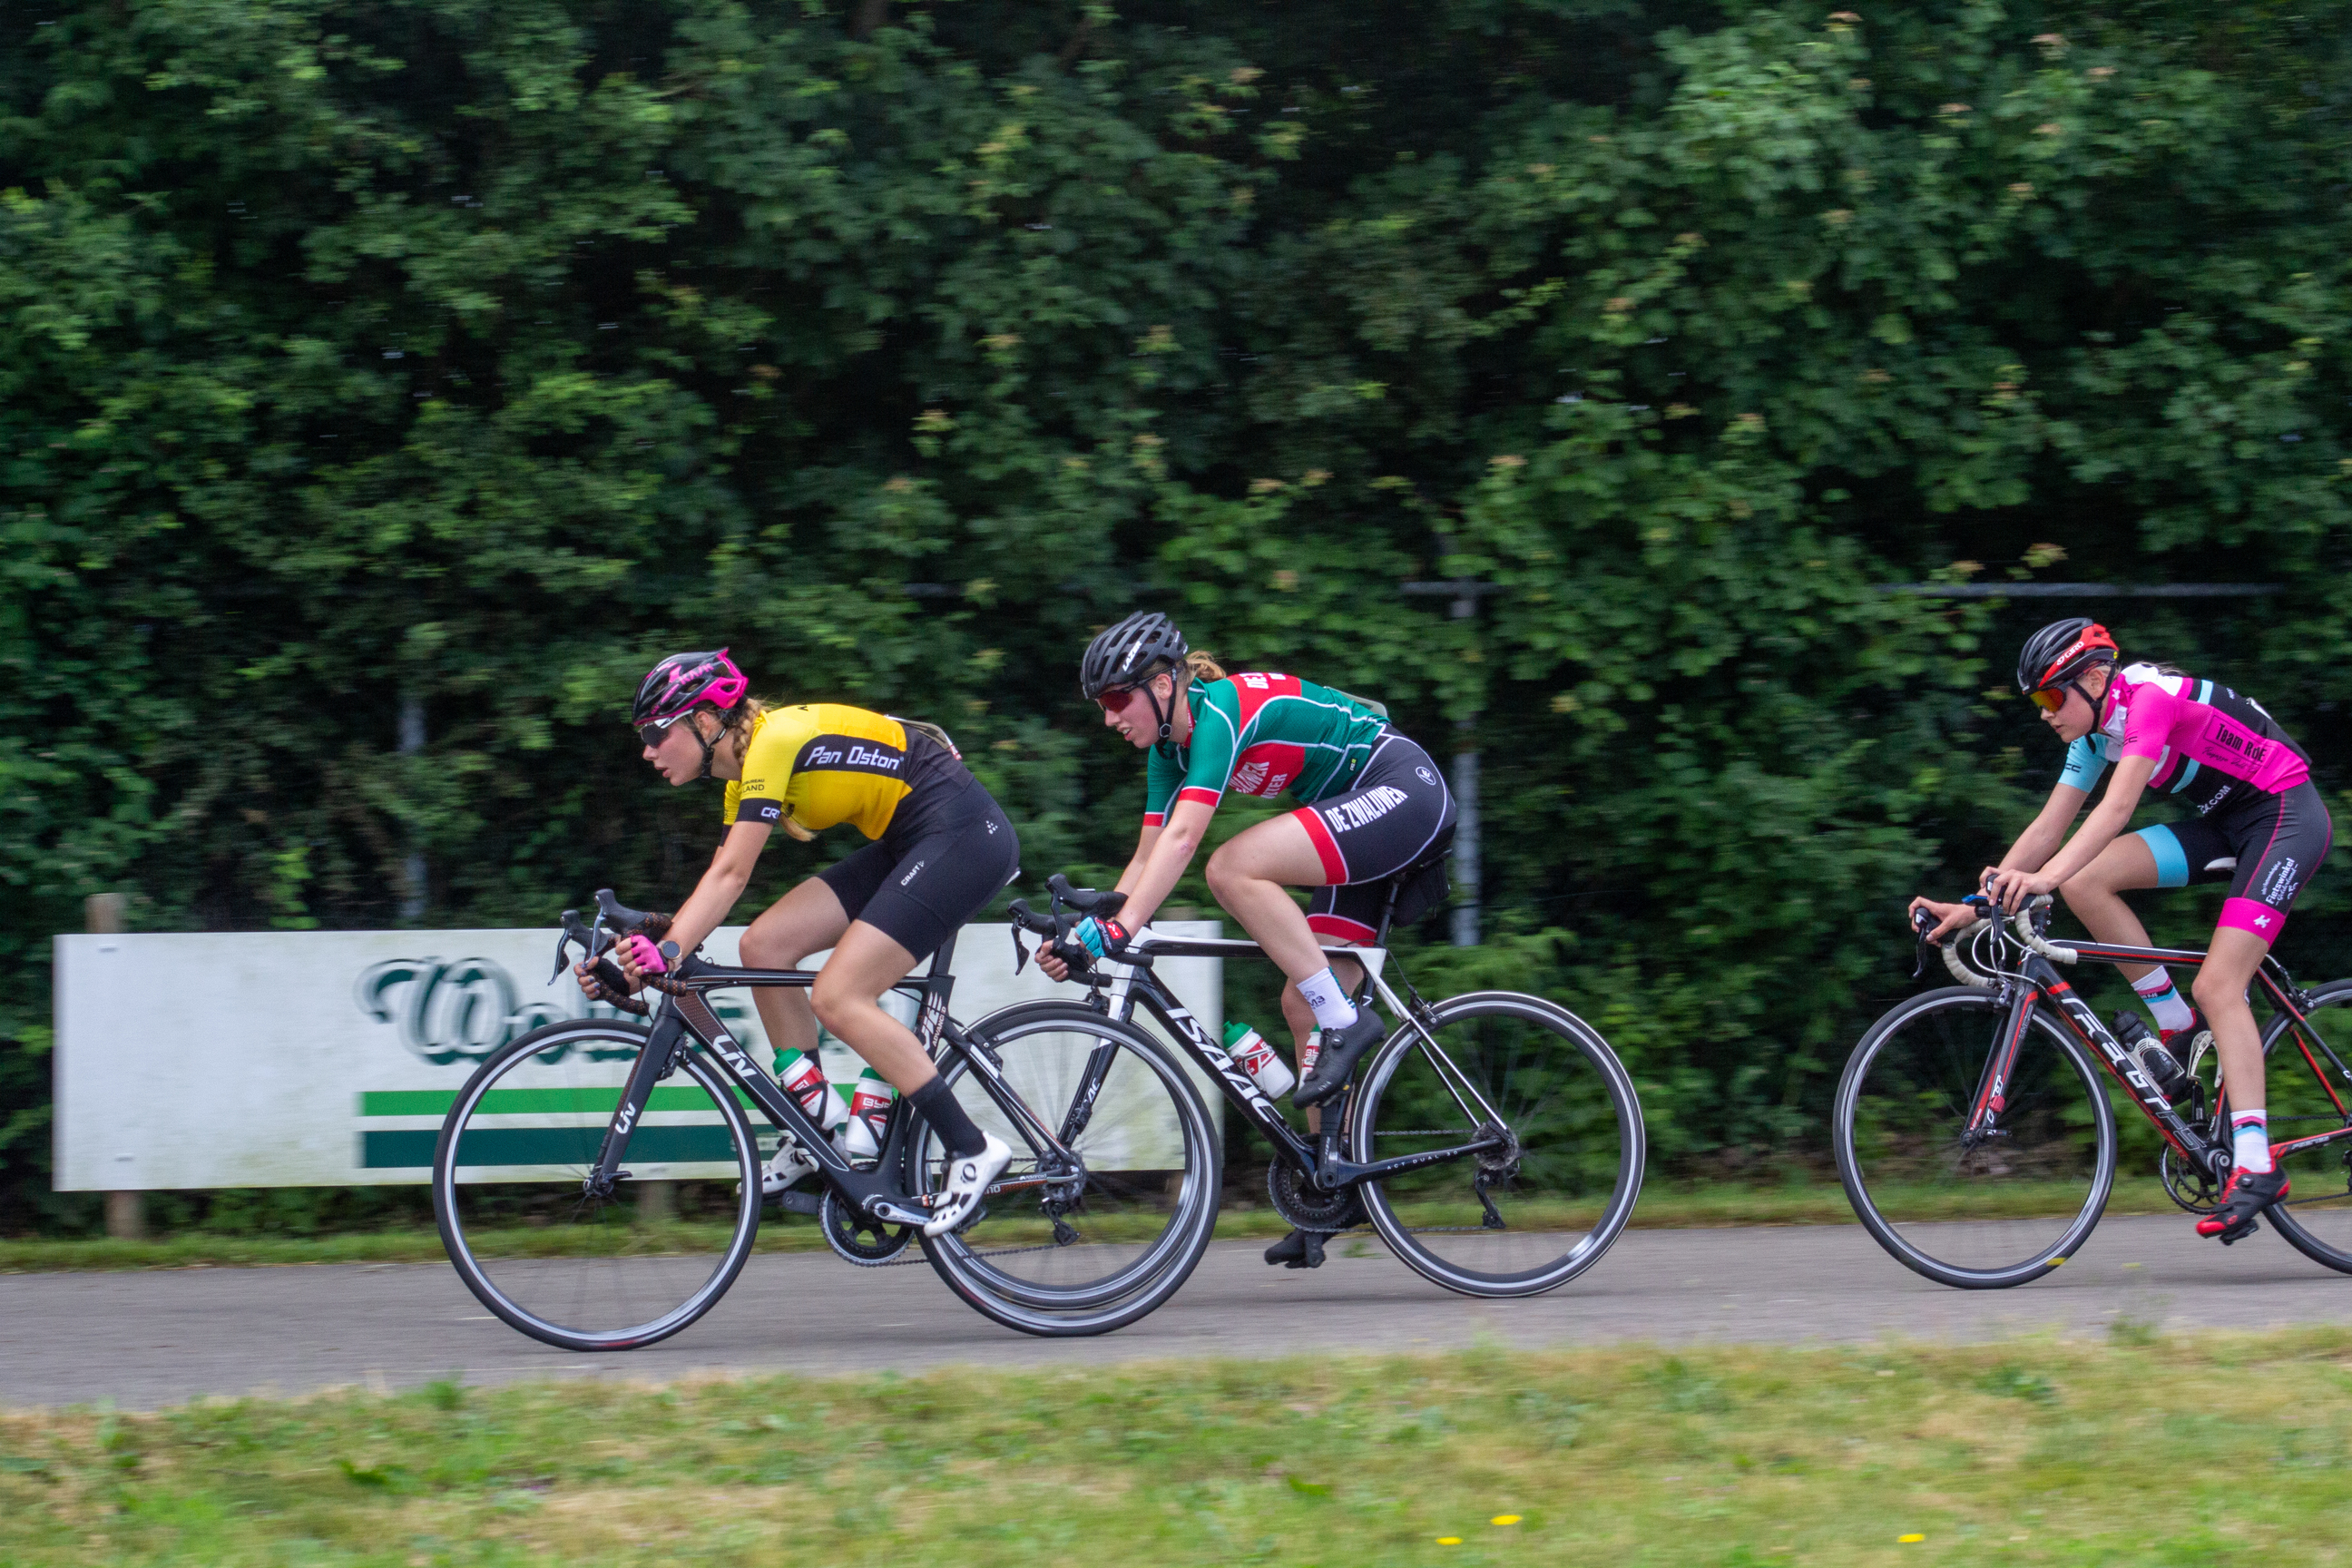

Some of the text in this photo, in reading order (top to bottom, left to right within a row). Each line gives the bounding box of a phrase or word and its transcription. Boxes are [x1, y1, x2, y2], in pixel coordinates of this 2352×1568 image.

[1122, 641, 1142, 671] LAZER
[2064, 641, 2085, 659] GIRO
[2216, 723, 2244, 751] Team
[804, 746, 900, 770] Pan Oston
[1325, 785, 1408, 833] DE ZWALUWEN
[900, 864, 921, 887] CRAFT
[2265, 857, 2295, 905] Fietswinkel
[1165, 1007, 1284, 1122] ISAAC
[1387, 1150, 1458, 1171] ACT DUAL 30
